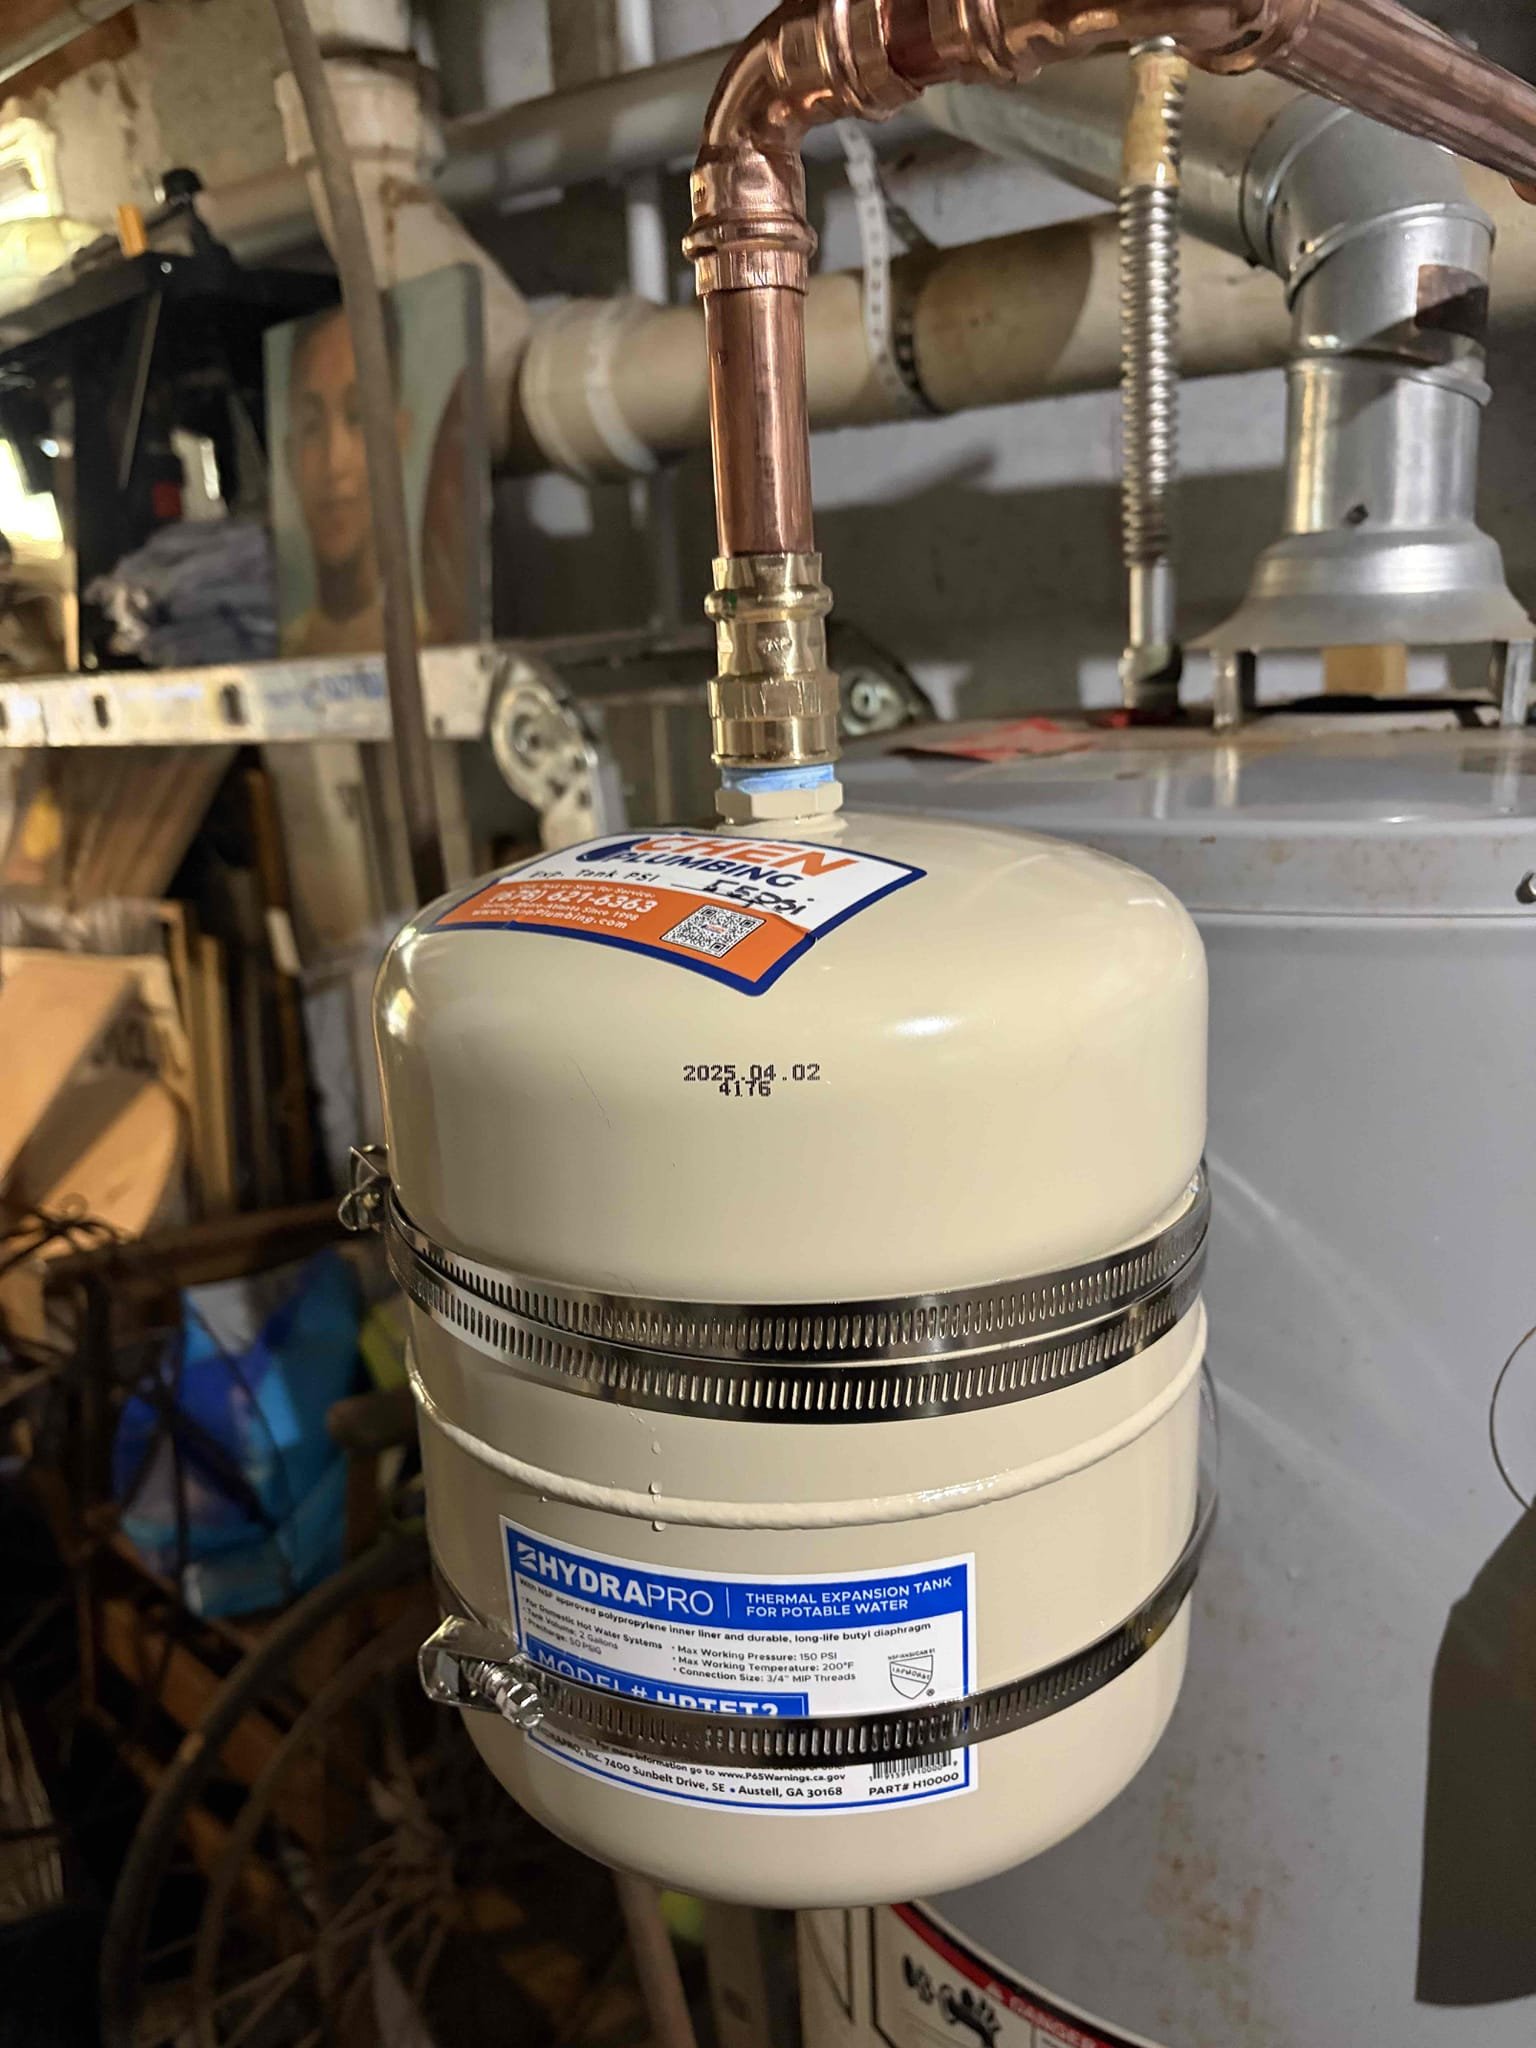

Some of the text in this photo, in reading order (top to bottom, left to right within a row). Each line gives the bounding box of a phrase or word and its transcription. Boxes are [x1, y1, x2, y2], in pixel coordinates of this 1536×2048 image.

[634, 837, 860, 877] CHEN
[576, 869, 617, 878] Tank
[623, 872, 660, 882] PSI
[603, 852, 804, 887] PLUMBING
[547, 889, 658, 913] 621-6363
[683, 1063, 820, 1081] 2025.04.02
[719, 1080, 771, 1097] 4176
[539, 1551, 714, 1616] HYDRAPRO
[745, 1576, 952, 1604] THERMAL EXPANSION TANK
[556, 1596, 596, 1615] approved
[598, 1609, 667, 1632] polypropylene
[669, 1624, 695, 1636] inner
[698, 1629, 721, 1640] liner
[724, 1631, 744, 1641] and
[747, 1631, 792, 1643] durable,
[795, 1630, 839, 1643] long-life
[843, 1629, 871, 1642] butyl
[874, 1623, 931, 1639] diaphragm
[746, 1599, 908, 1618] FOR POTABLE WATER
[539, 1604, 574, 1624] Domestic
[577, 1620, 592, 1631] Hot
[594, 1625, 620, 1639] Water
[623, 1633, 663, 1650] Systems
[579, 1630, 585, 1639] 2
[587, 1633, 618, 1650] Gallons
[677, 1644, 837, 1662] Max Working Pressure: 150 PSI
[678, 1656, 854, 1674] Max Working Temperature: 200°F
[679, 1667, 736, 1681] Connection
[739, 1672, 764, 1682] Size:
[793, 1674, 811, 1682] MIP
[814, 1672, 856, 1682] Threads
[604, 1757, 630, 1772] 7400
[633, 1766, 673, 1784] Sunbelt
[676, 1776, 709, 1792] Drive,
[712, 1782, 725, 1793] SE
[738, 1785, 782, 1798] Austell,
[786, 1787, 804, 1797] GA
[807, 1786, 842, 1798] 30168
[635, 1754, 687, 1772] information
[690, 1767, 702, 1775] go
[705, 1768, 715, 1776] to
[718, 1771, 845, 1783] www.P65Warnings.ca.gov
[869, 1772, 959, 1796] PART# H10000
